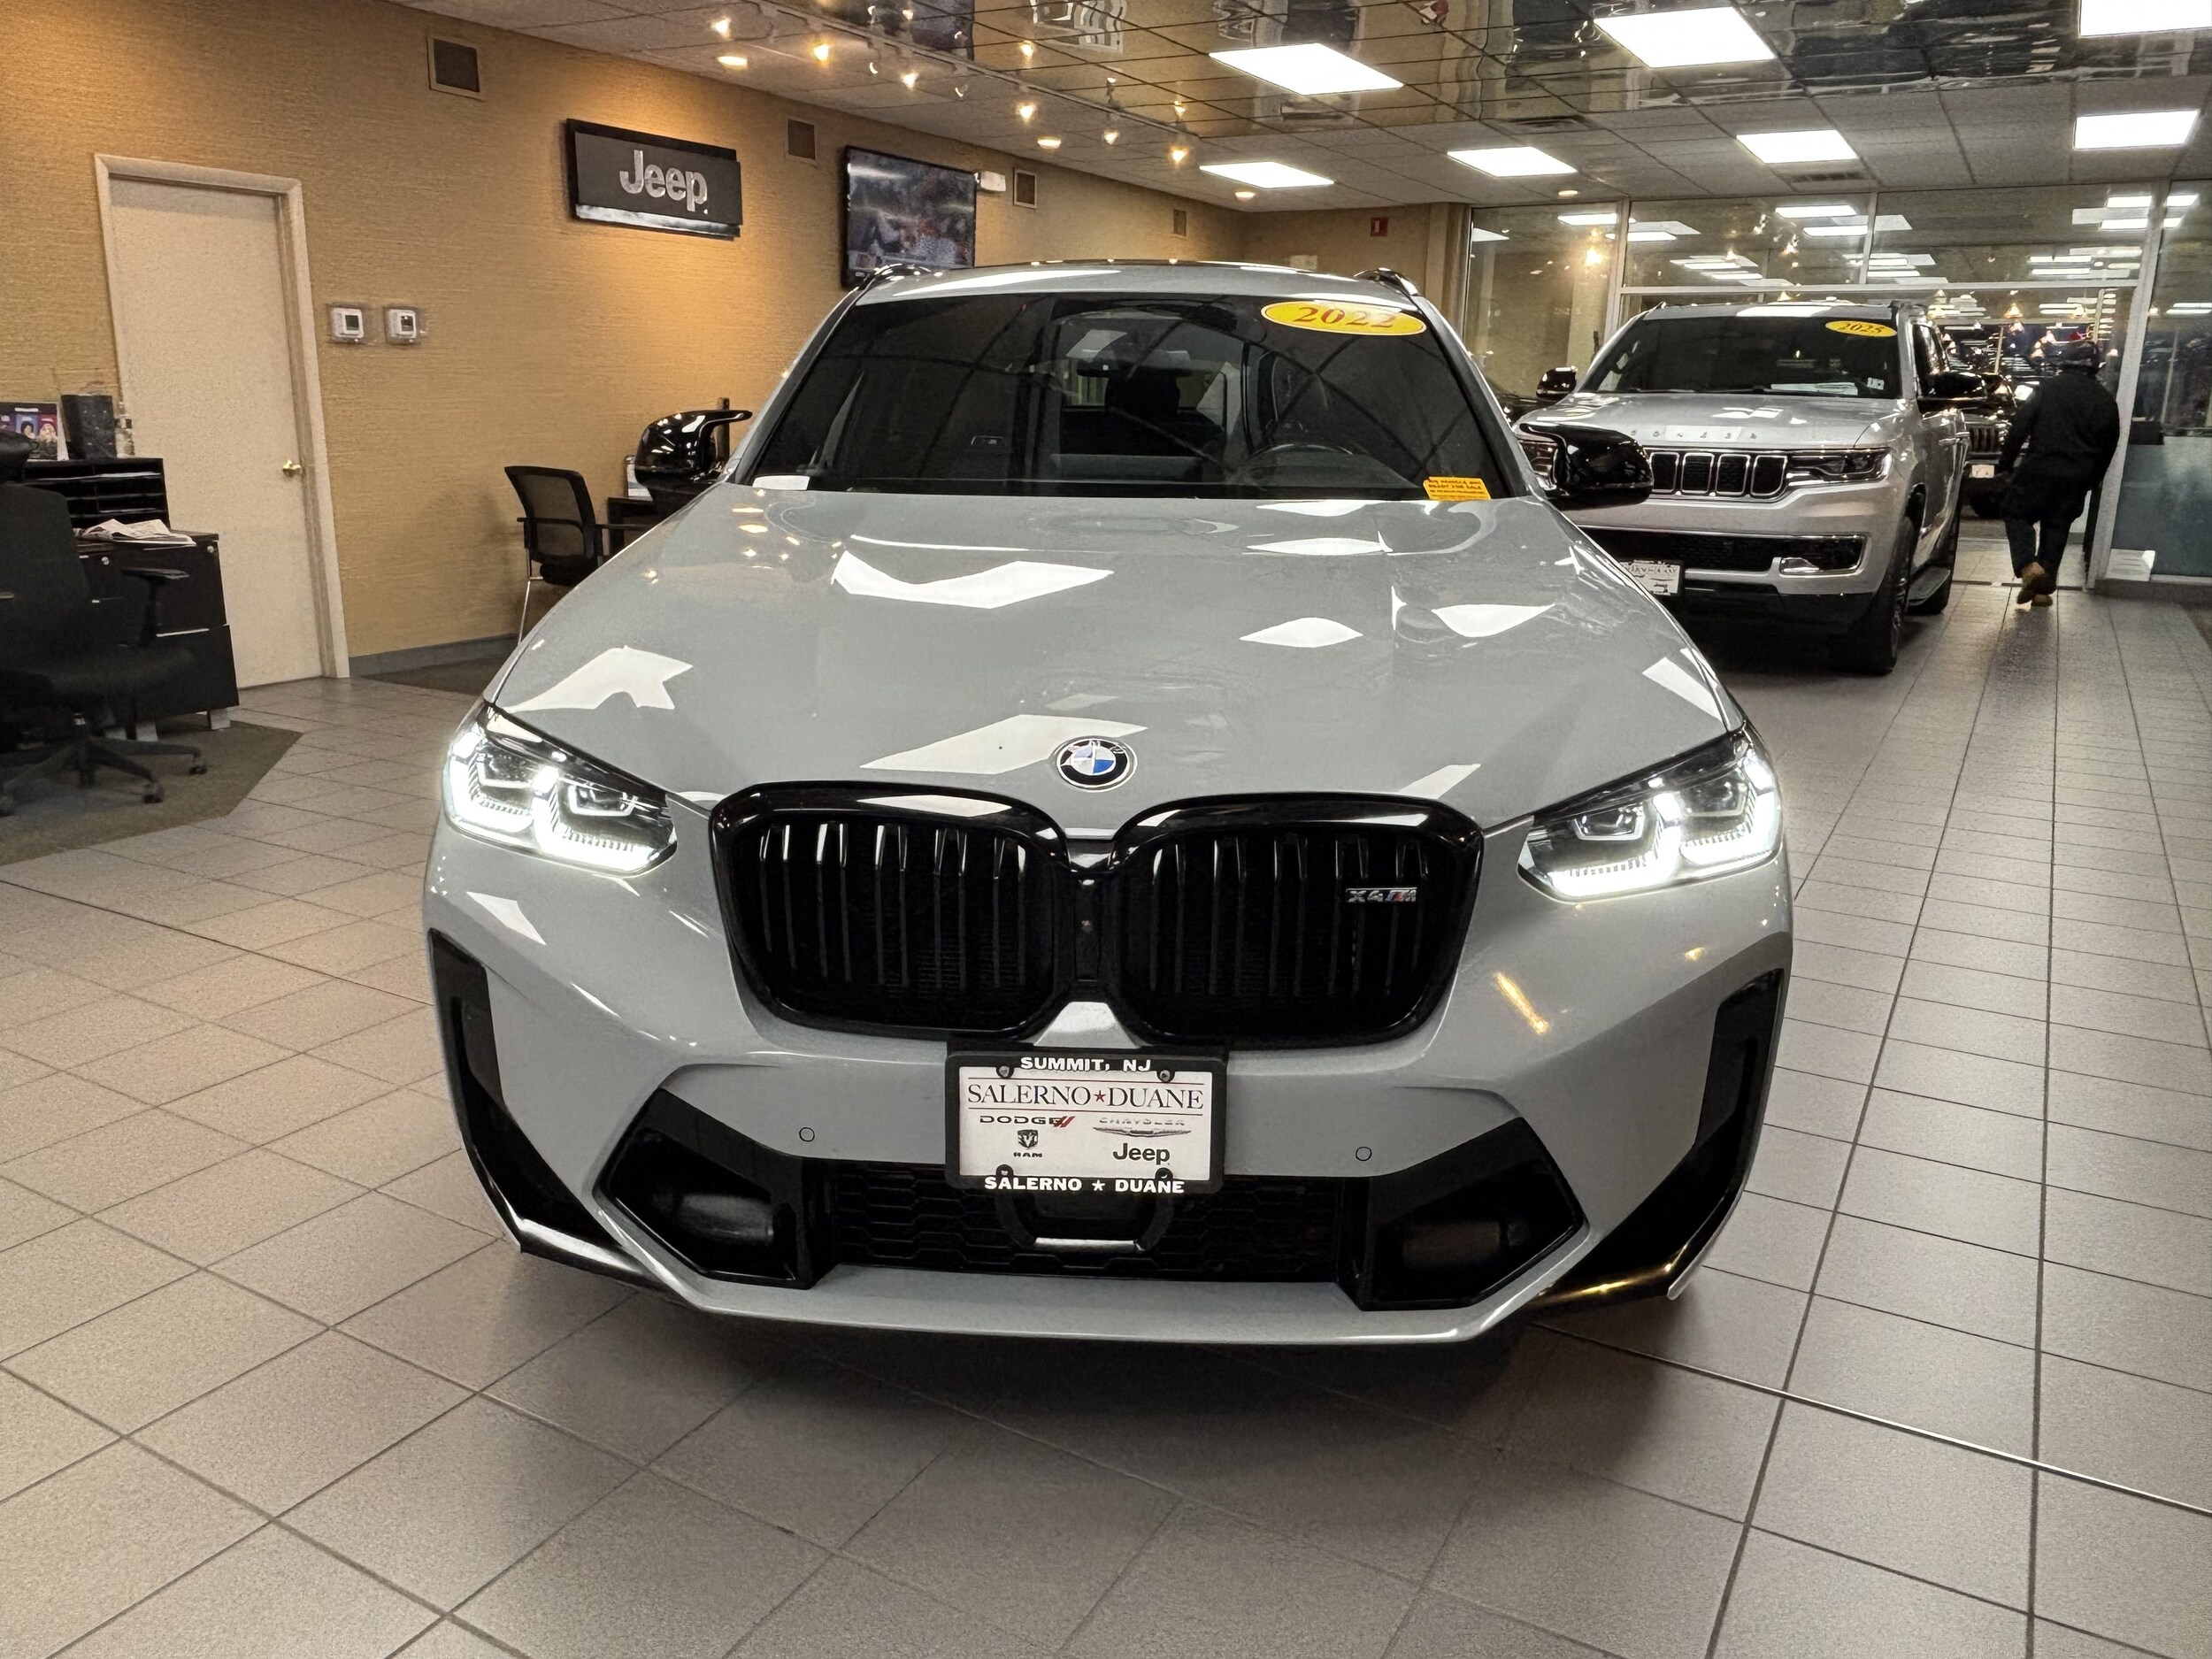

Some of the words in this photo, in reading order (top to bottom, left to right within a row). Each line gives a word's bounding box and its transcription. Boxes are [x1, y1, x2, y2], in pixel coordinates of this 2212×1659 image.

[619, 150, 708, 212] Jeep
[1294, 306, 1396, 327] 2022
[1837, 322, 1885, 334] 2025
[1123, 1059, 1151, 1071] NJ
[968, 1084, 1091, 1106] SALERNO
[1107, 1087, 1203, 1110] DUANE
[979, 1116, 1063, 1125] DODGE
[1113, 1143, 1171, 1164] Jeep
[984, 1176, 1082, 1191] SALERNO
[1115, 1179, 1185, 1194] DUANE
